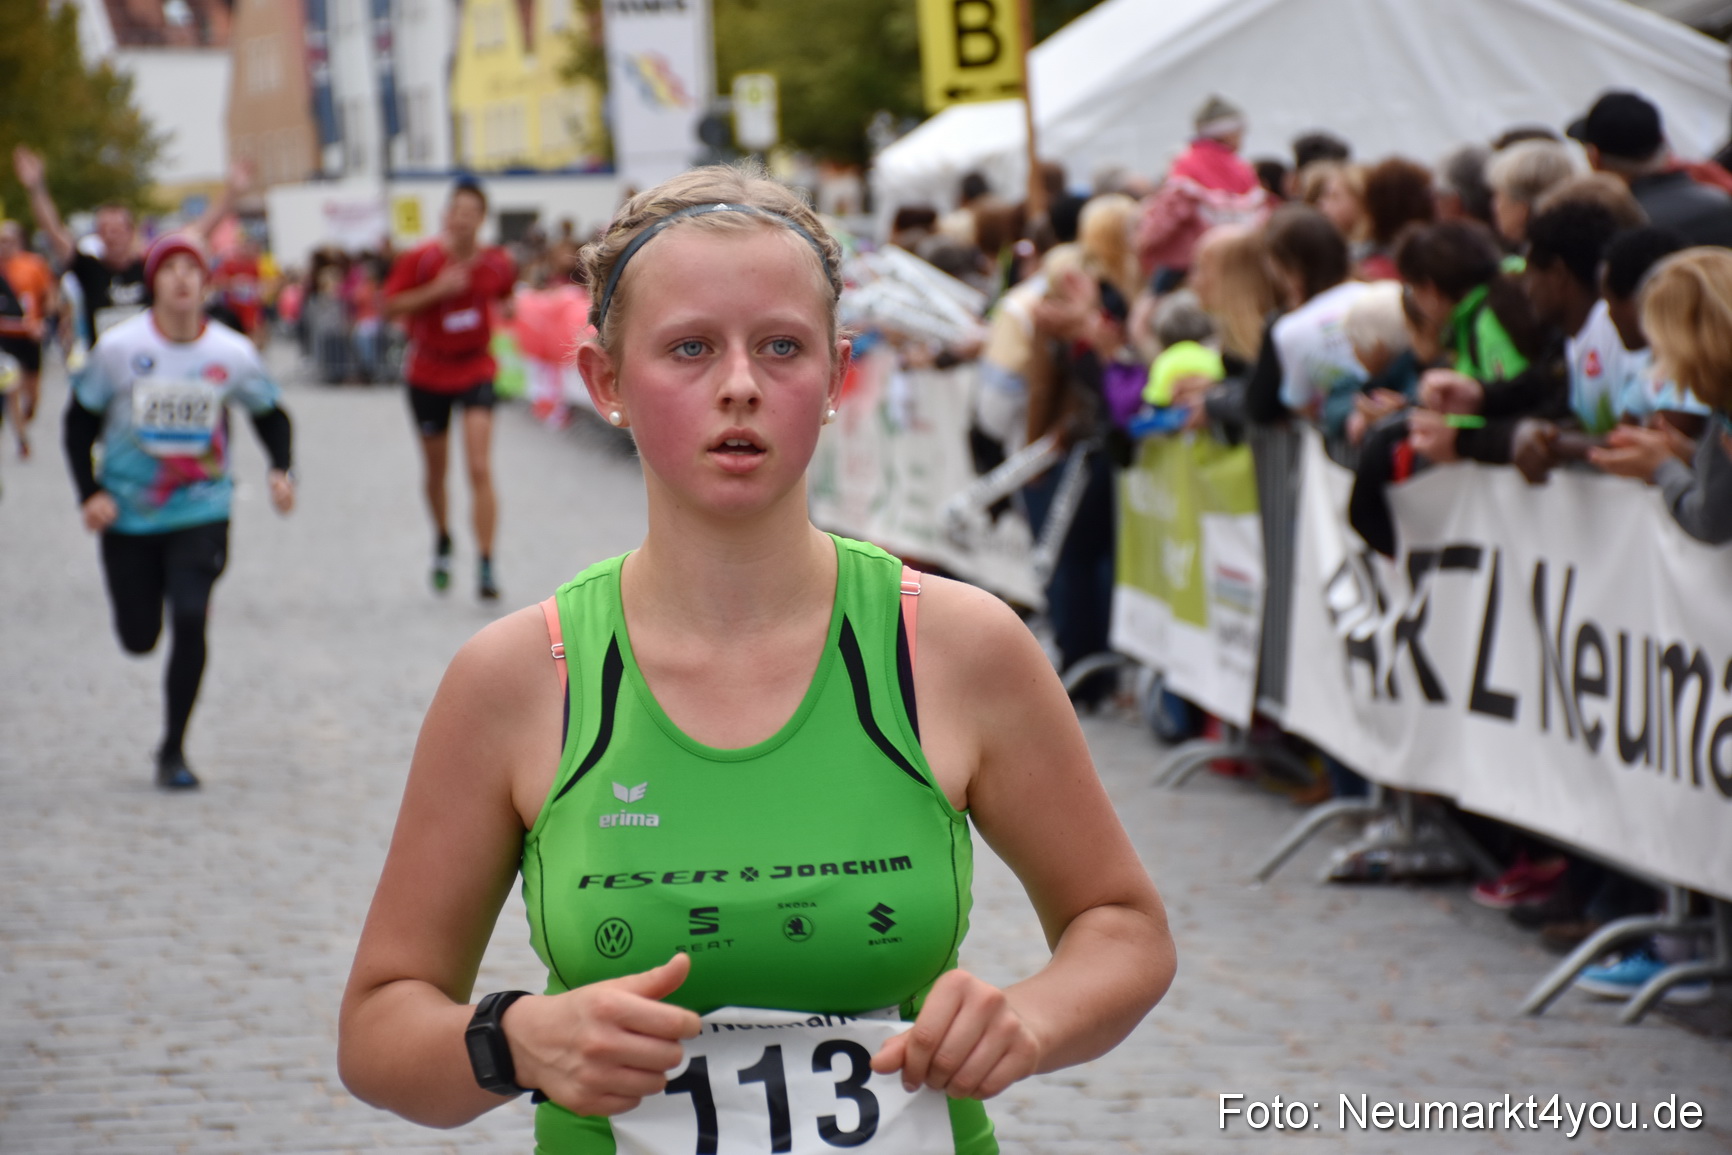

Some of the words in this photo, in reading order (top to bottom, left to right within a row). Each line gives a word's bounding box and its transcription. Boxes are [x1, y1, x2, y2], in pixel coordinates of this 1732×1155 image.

[954, 0, 1001, 68] B
[599, 810, 660, 828] erima
[578, 870, 729, 889] FESER
[769, 855, 912, 880] JOACHIM
[675, 938, 735, 954] SEAT
[664, 1039, 880, 1155] 113
